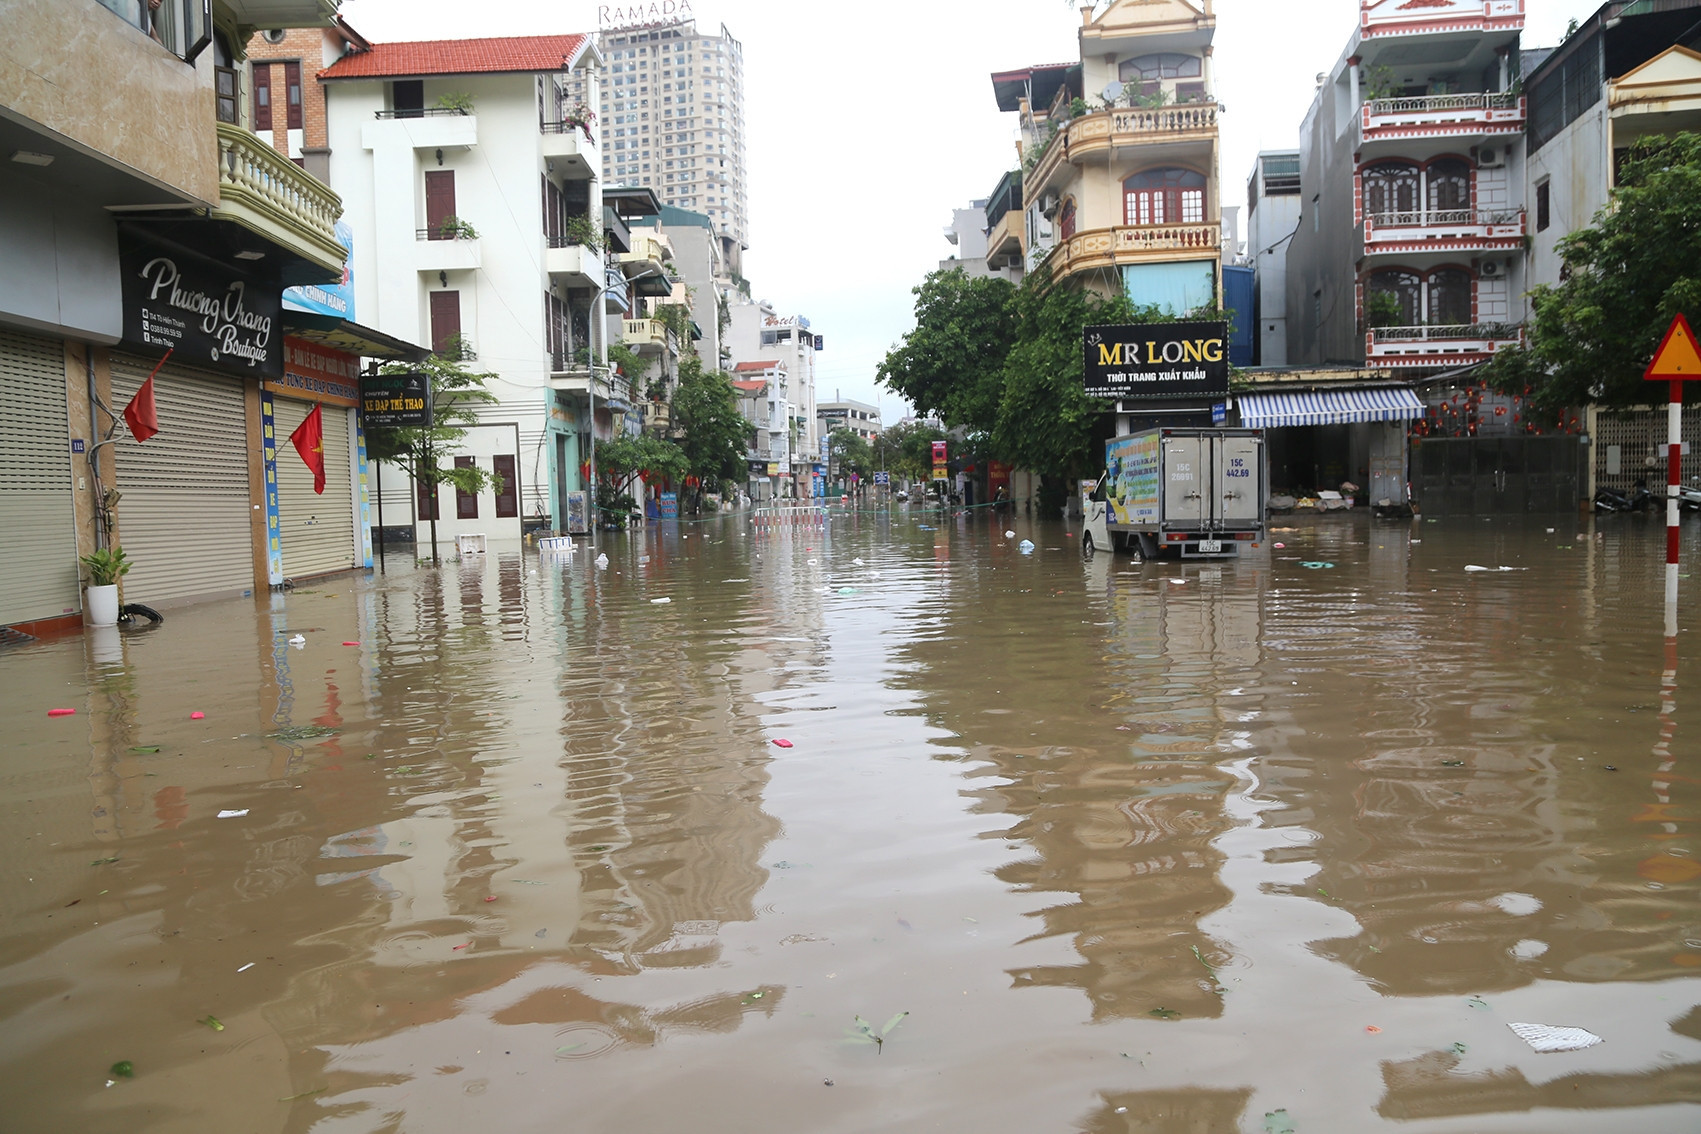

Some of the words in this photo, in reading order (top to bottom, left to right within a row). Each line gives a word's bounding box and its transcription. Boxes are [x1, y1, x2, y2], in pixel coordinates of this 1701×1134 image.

[598, 0, 692, 25] RAMADA
[142, 257, 220, 334] Phương
[217, 324, 267, 366] Boutique
[1098, 343, 1141, 366] MR
[1145, 338, 1224, 364] LONG
[1106, 371, 1127, 383] THỜI
[1128, 372, 1157, 382] TRANG
[1158, 367, 1181, 381] XUẤT
[1182, 366, 1206, 380] KHẨU
[364, 399, 375, 411] XE
[375, 399, 390, 414] ĐẠP
[390, 392, 404, 411] THỂ
[404, 397, 424, 410] THAO
[1176, 463, 1190, 471] 15C
[1231, 458, 1244, 467] 15C
